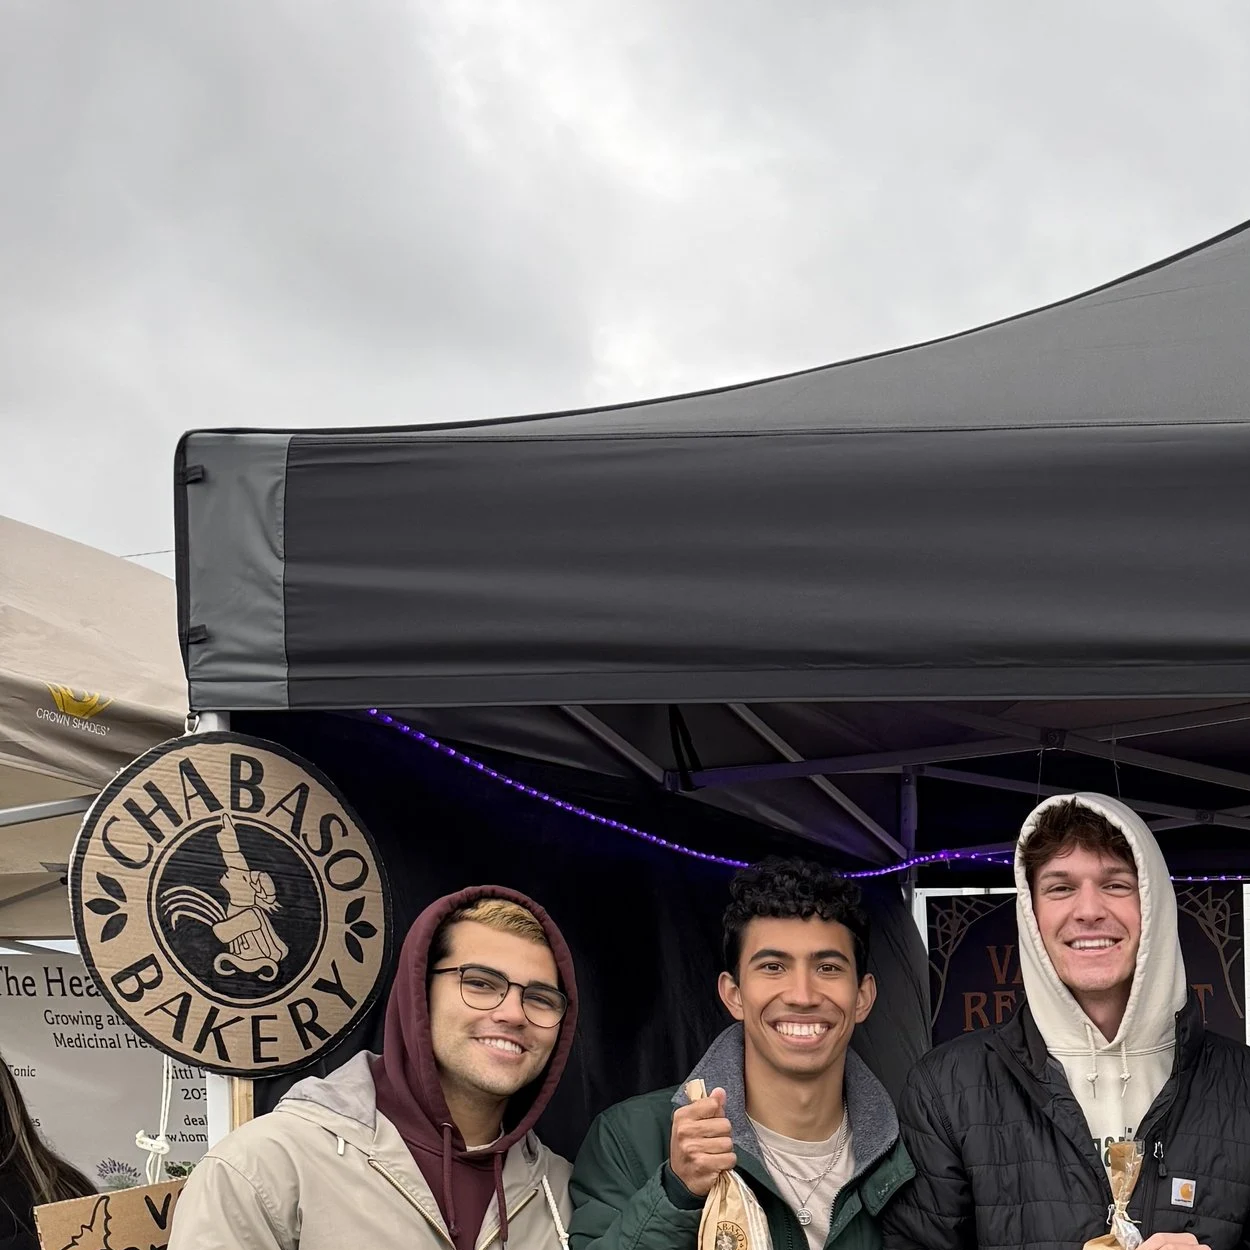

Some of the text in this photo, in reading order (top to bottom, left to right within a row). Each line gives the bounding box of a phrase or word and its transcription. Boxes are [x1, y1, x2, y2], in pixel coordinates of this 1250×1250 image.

[36, 707, 107, 736] CROWN SHADES
[101, 752, 370, 891] CHABASO
[43, 966, 101, 998] Hea
[43, 1009, 104, 1030] Growing
[110, 952, 358, 1064] BAKERY
[53, 1032, 121, 1049] Medicinal
